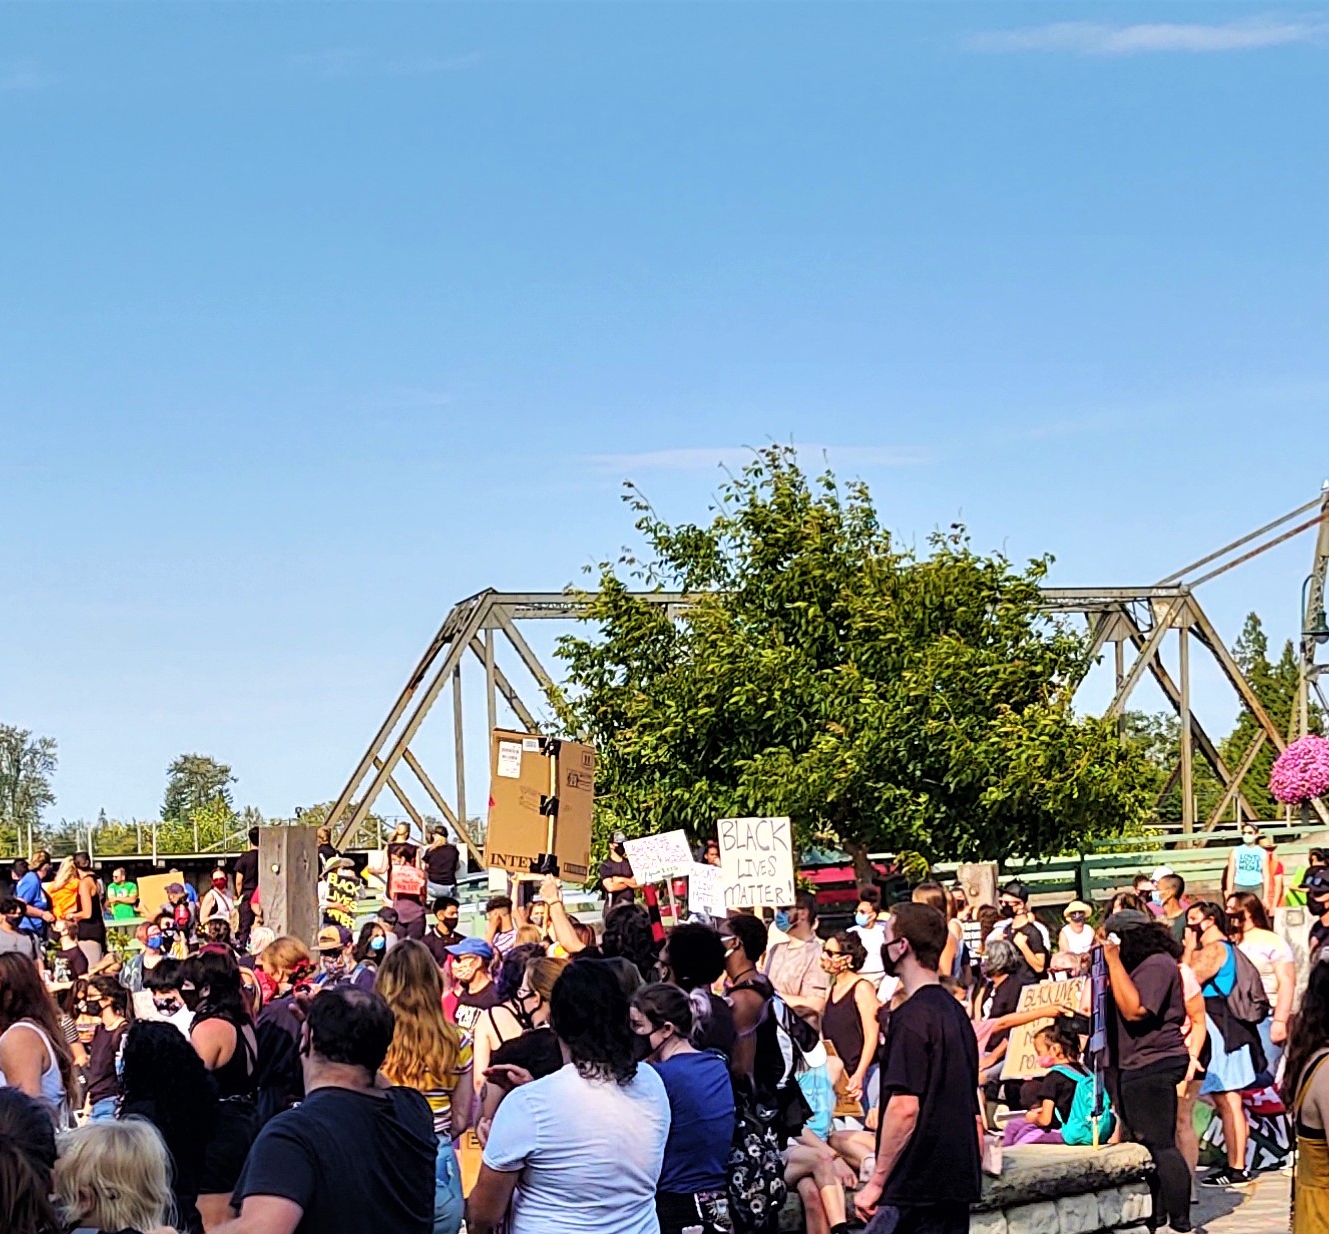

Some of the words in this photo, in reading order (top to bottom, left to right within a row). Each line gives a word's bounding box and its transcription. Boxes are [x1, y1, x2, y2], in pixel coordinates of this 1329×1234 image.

[721, 820, 788, 851] BLACK
[737, 855, 777, 879] LIVES
[328, 872, 361, 897] BLACK
[724, 880, 793, 907] MATTER!
[327, 889, 358, 912] LIVES
[1024, 984, 1051, 1008] BLACK
